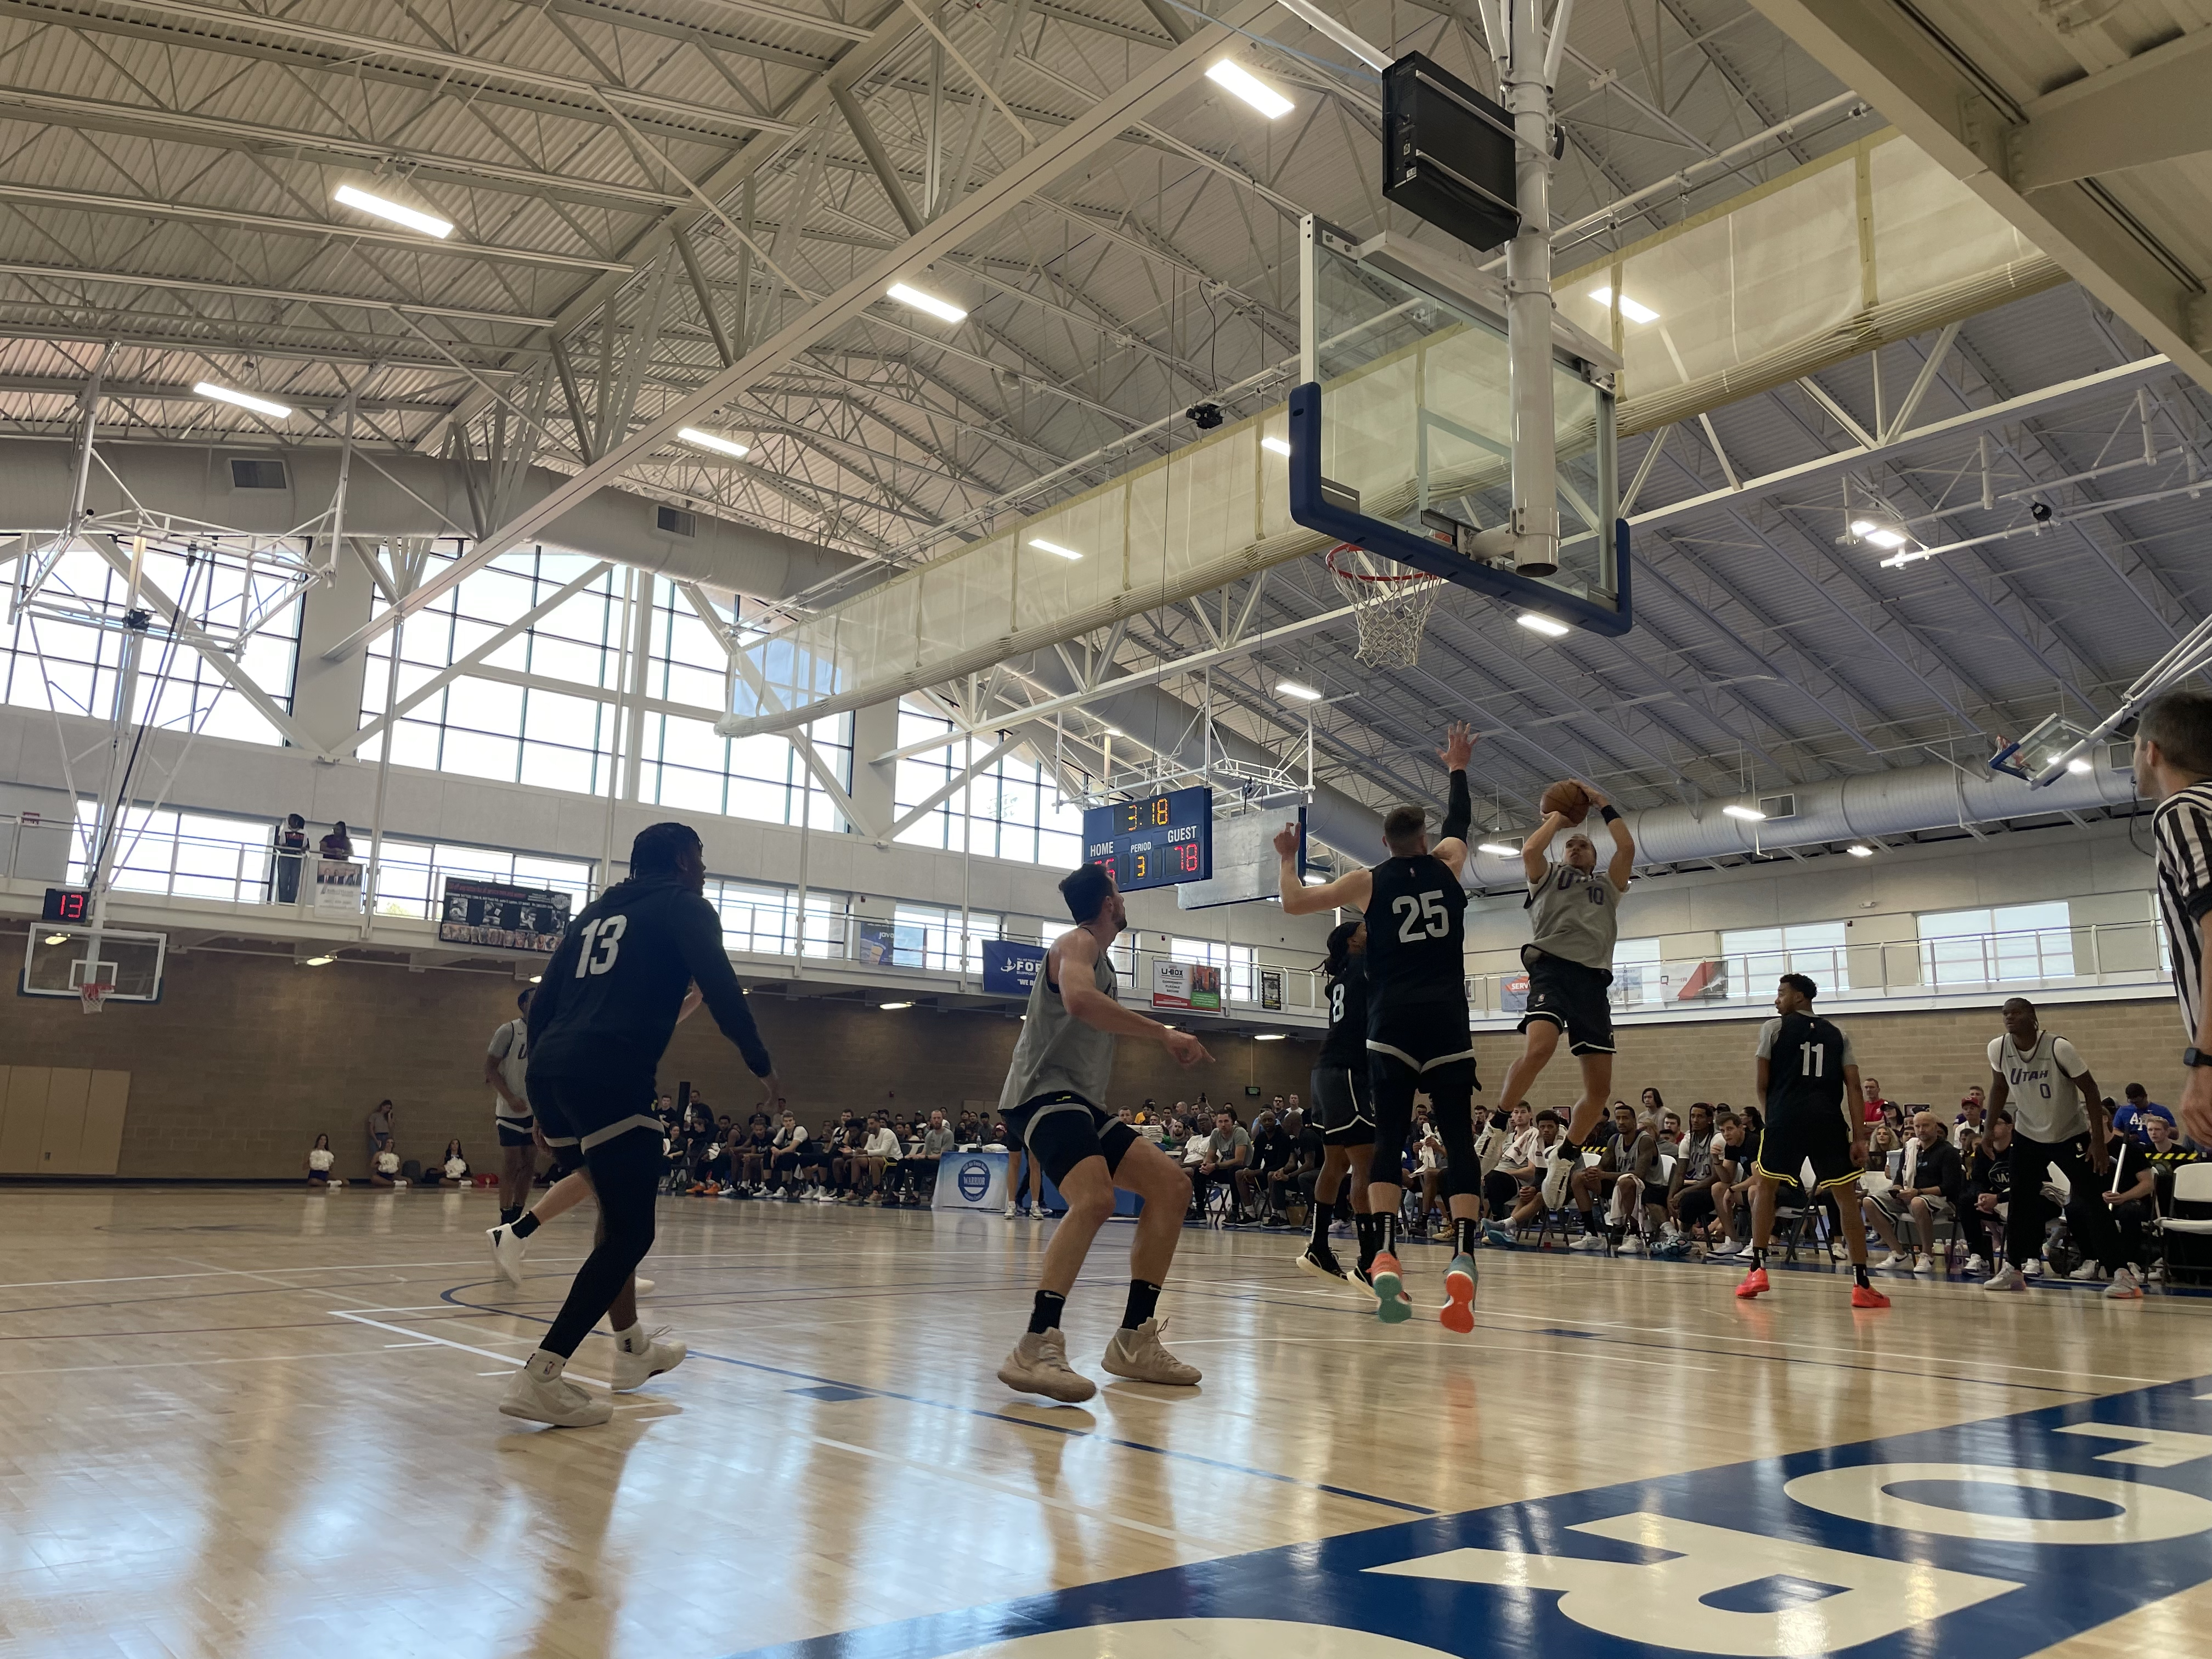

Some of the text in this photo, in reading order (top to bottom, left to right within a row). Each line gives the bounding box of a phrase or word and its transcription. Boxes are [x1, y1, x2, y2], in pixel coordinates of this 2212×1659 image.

[1128, 798, 1168, 831] 3:18
[1167, 825, 1197, 843] GUEST
[1090, 841, 1114, 857] HOME
[1130, 841, 1152, 854] PERIOD
[1174, 843, 1198, 872] 78
[1137, 855, 1145, 877] 3
[1585, 885, 1604, 905] 10
[60, 894, 83, 918] 13
[1392, 889, 1449, 943] 25
[575, 914, 627, 978] 13
[1161, 968, 1183, 977] U-BOX
[1800, 1041, 1824, 1077] 11
[2040, 1083, 2051, 1099] 0
[963, 1176, 985, 1186] WARRIOR
